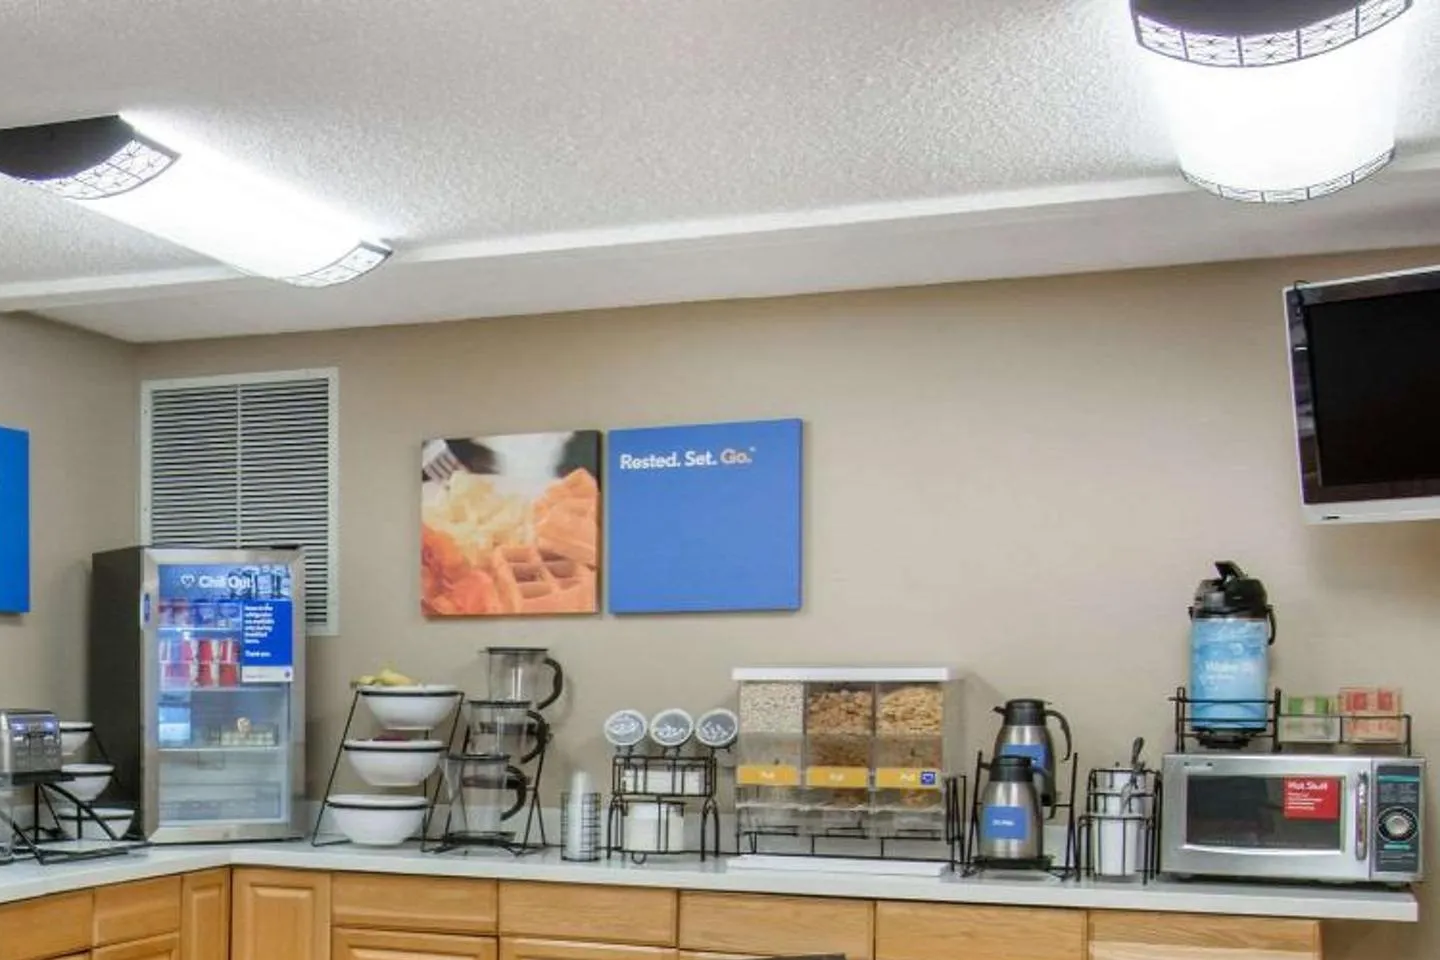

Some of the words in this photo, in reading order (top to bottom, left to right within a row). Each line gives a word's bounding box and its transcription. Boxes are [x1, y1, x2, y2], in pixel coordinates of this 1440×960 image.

[620, 451, 681, 470] Rested.
[684, 450, 718, 467] Set.
[198, 575, 226, 589] Chill
